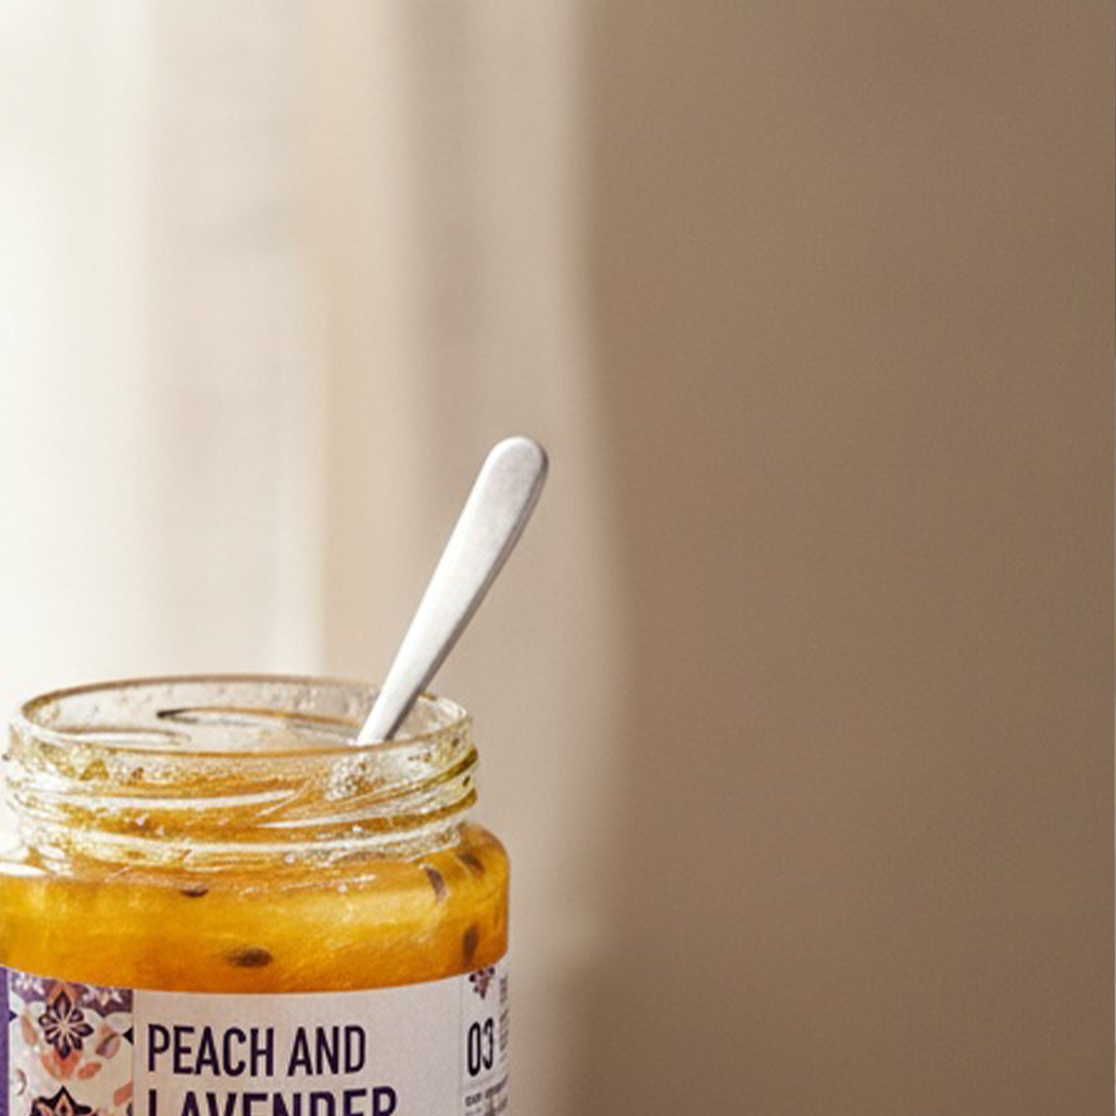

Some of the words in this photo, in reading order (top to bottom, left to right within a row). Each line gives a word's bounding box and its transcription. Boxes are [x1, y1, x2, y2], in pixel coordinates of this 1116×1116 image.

[148, 1023, 275, 1077] PEACH
[286, 1025, 367, 1077] AND
[467, 1017, 495, 1077] 03
